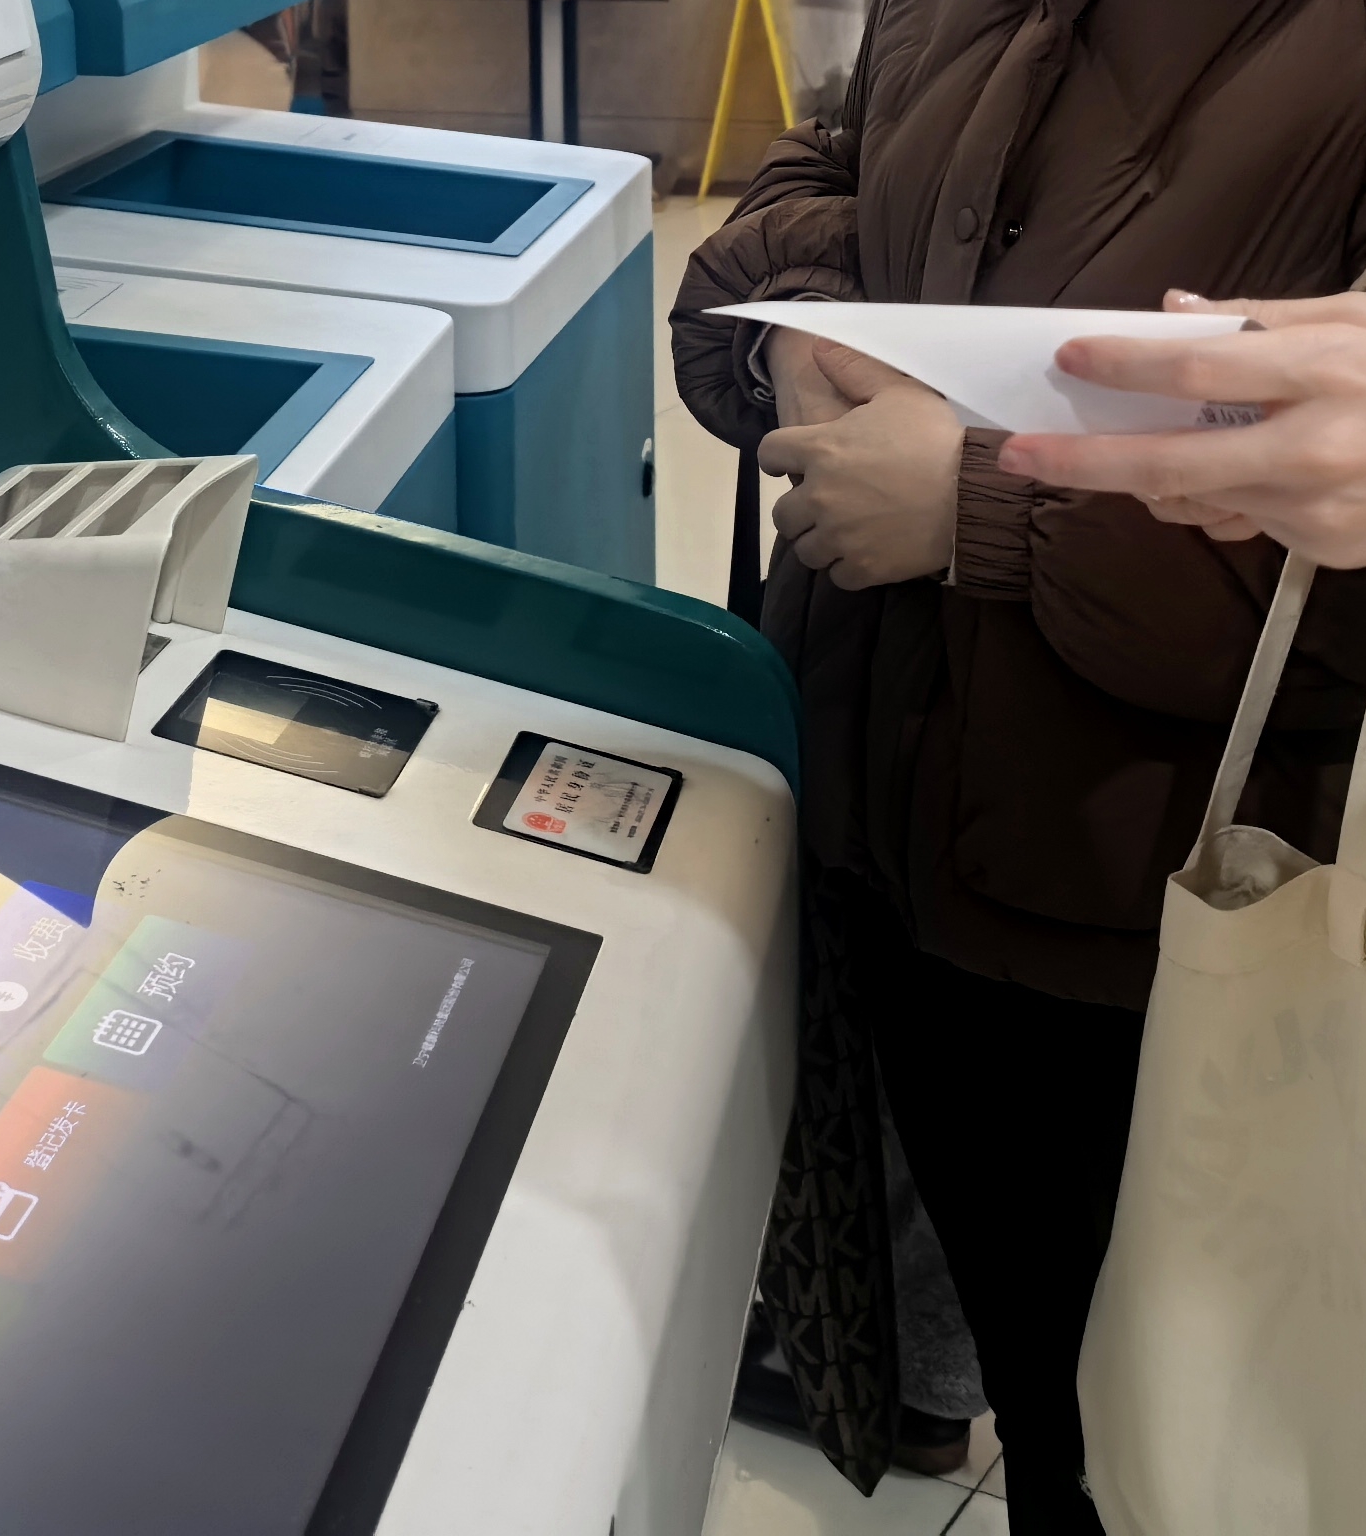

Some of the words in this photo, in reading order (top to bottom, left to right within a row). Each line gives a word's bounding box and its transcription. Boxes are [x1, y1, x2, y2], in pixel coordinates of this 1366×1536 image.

[555, 758, 599, 815] 居民身份证
[13, 916, 74, 964] 收费
[136, 951, 196, 1002] 预约
[22, 1099, 89, 1171] 登记发卡
